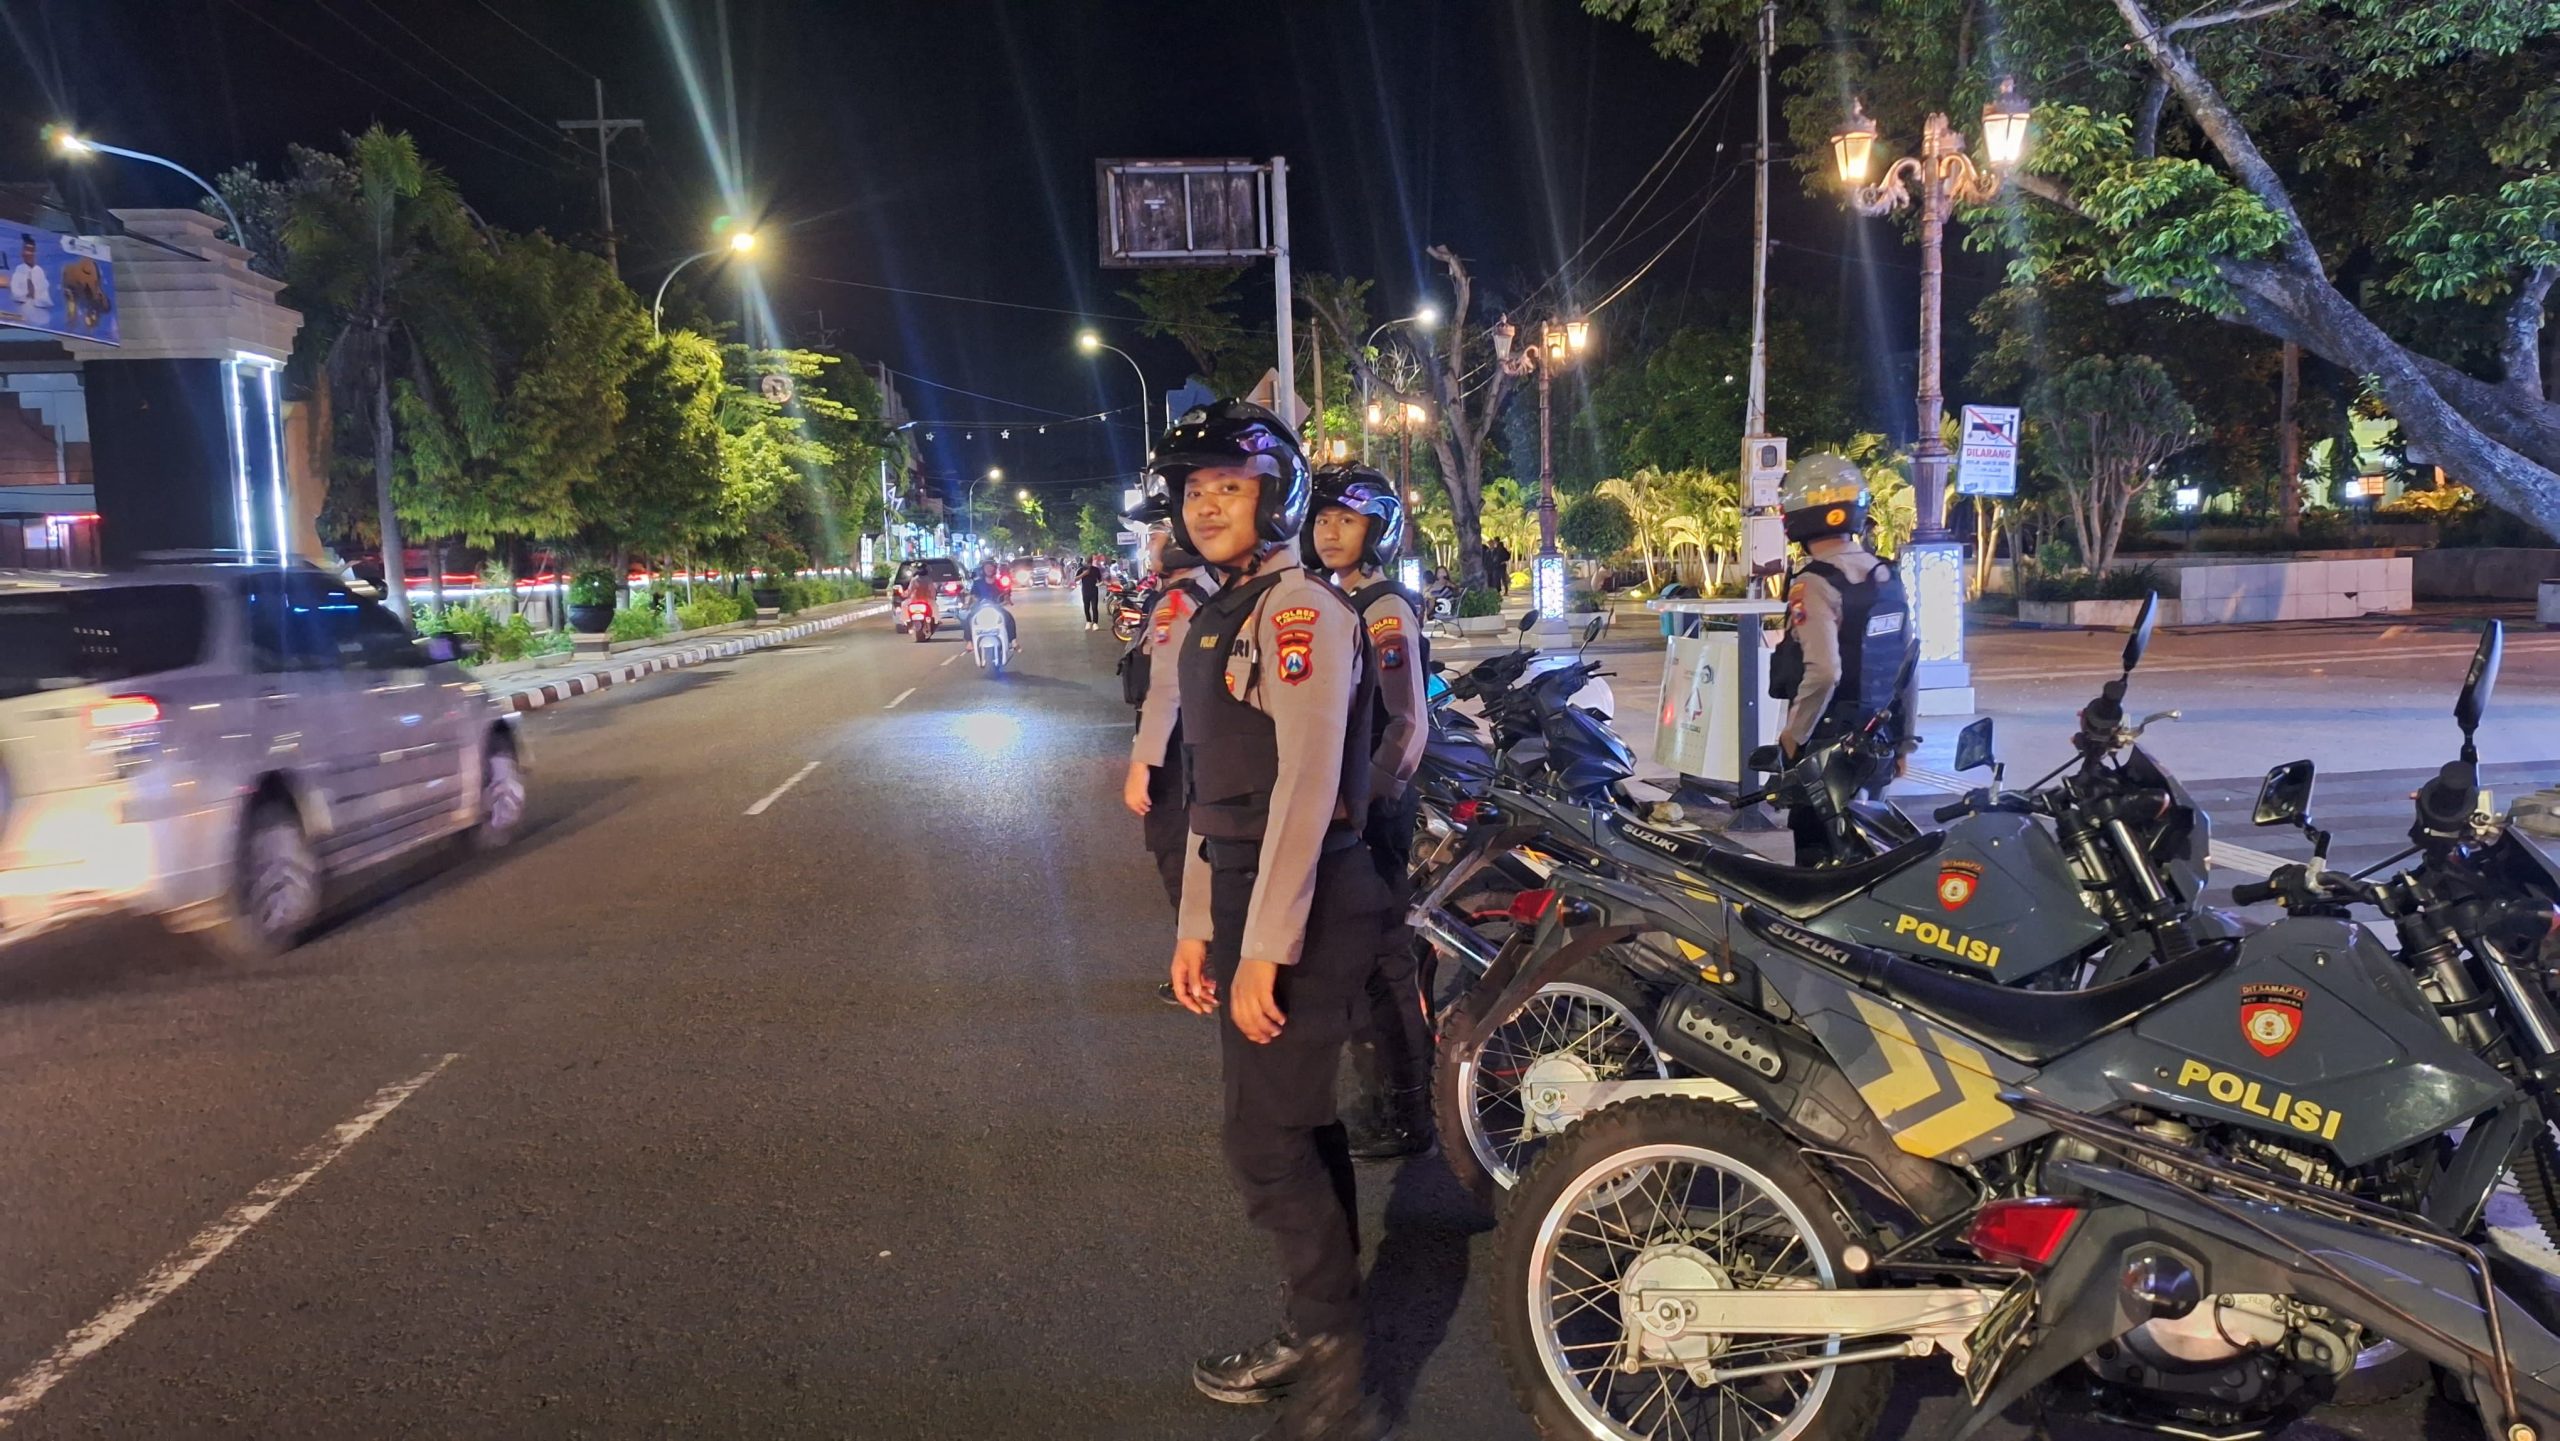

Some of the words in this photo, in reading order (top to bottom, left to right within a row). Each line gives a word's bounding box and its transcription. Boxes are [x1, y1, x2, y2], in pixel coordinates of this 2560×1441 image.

[1966, 447, 2012, 459] DILARANG
[1275, 609, 1316, 624] POLRES
[1370, 618, 1399, 634] POLRES
[1229, 639, 1250, 658] RI
[1622, 823, 1679, 853] SUZUKI
[1767, 922, 1852, 964] SUZUKI
[1895, 913, 2001, 967] POLISI
[2242, 985, 2257, 994] DIT
[2260, 985, 2305, 998] SAMAPTA
[2177, 1058, 2342, 1141] POLISI
